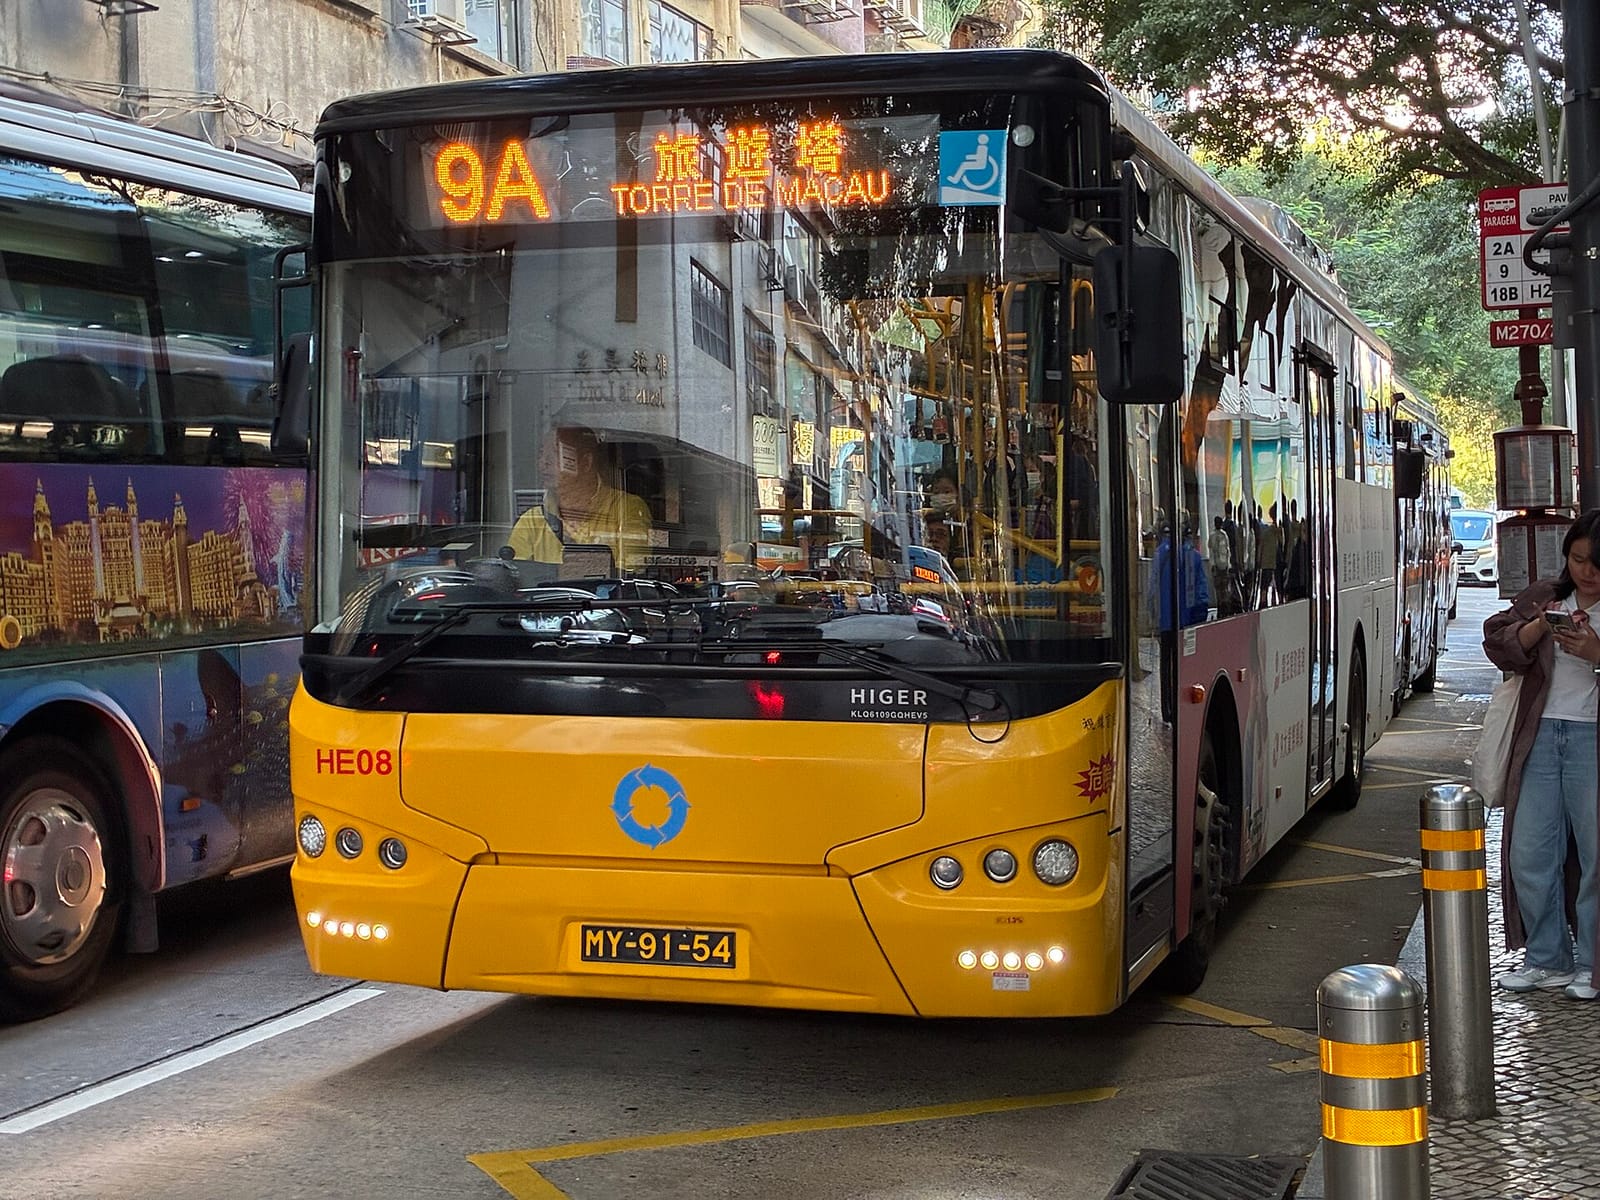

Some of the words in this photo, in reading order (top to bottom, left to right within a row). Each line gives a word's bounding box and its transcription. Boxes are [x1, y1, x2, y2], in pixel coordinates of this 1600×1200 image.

[654, 124, 842, 182] 旅遊塔
[435, 141, 551, 222] 9A
[610, 182, 714, 215] TORRE
[722, 180, 766, 210] DE
[775, 170, 890, 206] MACAU
[1549, 193, 1569, 204] PAV
[1483, 215, 1517, 227] PARAGEM
[1492, 241, 1515, 256] 2A
[1499, 264, 1509, 279] 9
[1490, 286, 1519, 302] 18B
[1496, 323, 1553, 341] M270/
[850, 688, 928, 706] HIGER
[316, 748, 393, 775] HE08
[585, 929, 731, 963] MY-91-54
